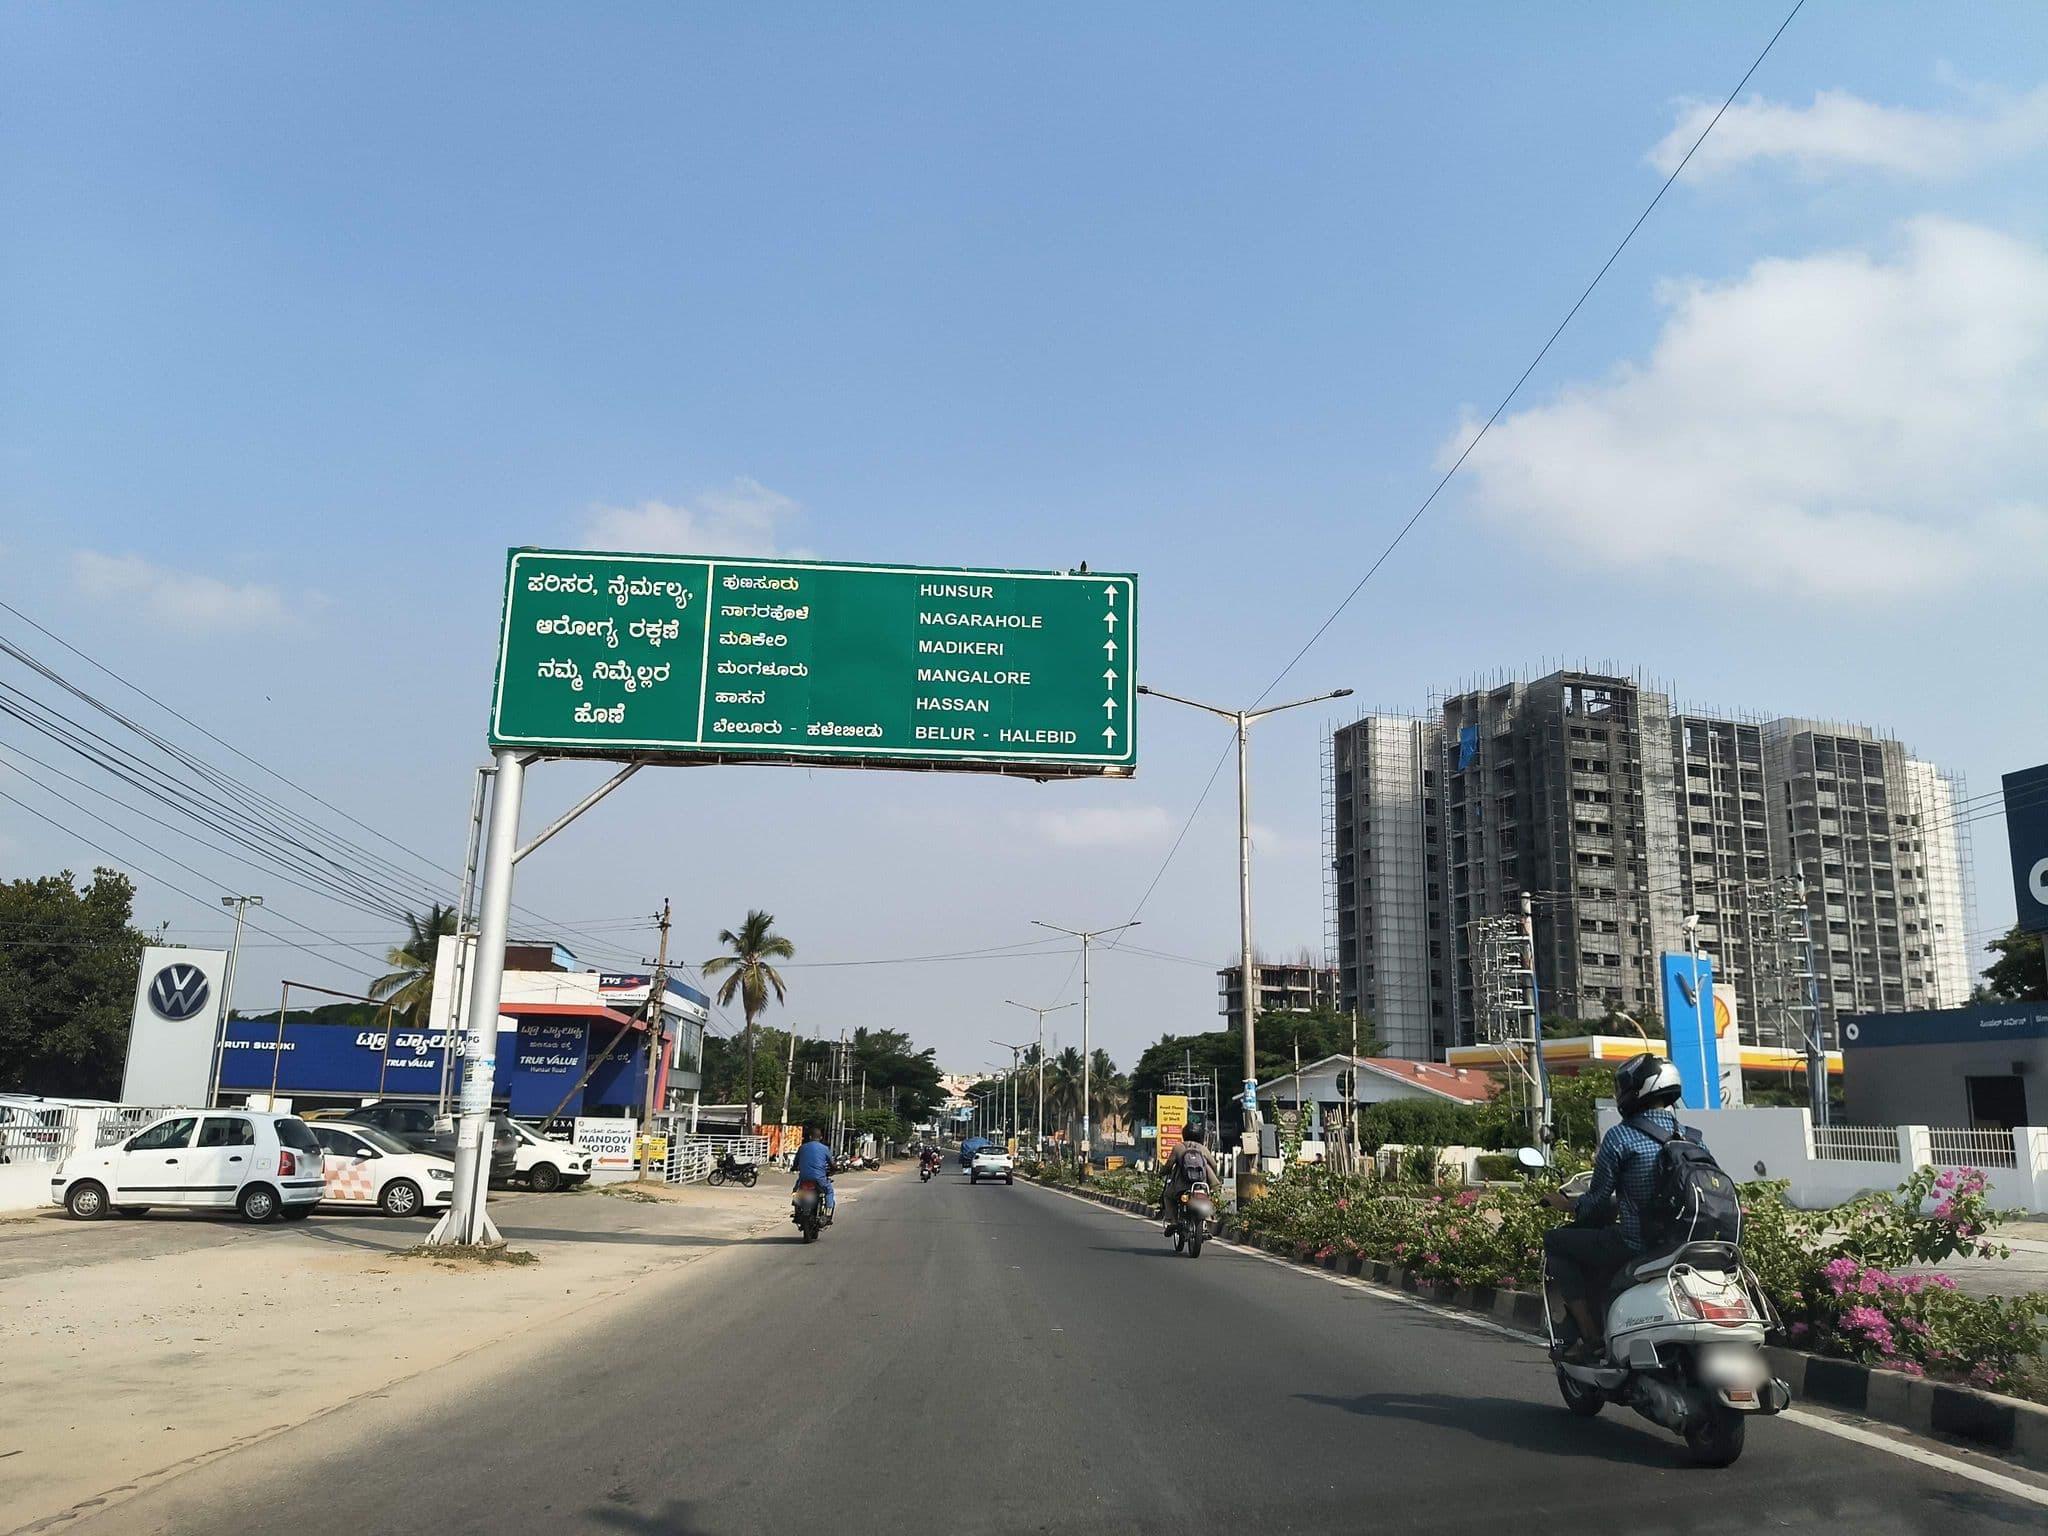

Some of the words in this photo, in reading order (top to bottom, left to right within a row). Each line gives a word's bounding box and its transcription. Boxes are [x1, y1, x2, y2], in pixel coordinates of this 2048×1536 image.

[722, 574, 800, 591] ಹುಣಸೂರು
[527, 572, 598, 596] ಪರಿಸರ,
[607, 574, 693, 610] ನೈರ್ಮಲ್ಯ,
[920, 584, 994, 599] HUNSUR
[720, 603, 810, 622] ನಾಗರಹೊಳೆ
[919, 612, 1043, 629] NAGARAHOLE
[535, 614, 619, 649] ಆರೋಗ್ಯ
[629, 618, 680, 648] ರಕ್ಷಣೆ
[719, 630, 788, 647] ಮಡಿಕೇರಿ
[918, 640, 1004, 656] MADIKERI
[537, 657, 584, 692] ನಮ್ಮ
[592, 659, 671, 693] ನಿಮ್ಮೆಲ್ಲರ
[717, 659, 809, 677] ಮಂಗಳೂರು
[917, 668, 1031, 685] MANGALORE
[715, 689, 766, 705] ಹಾಸನ
[916, 697, 989, 713] HASSAN
[574, 702, 626, 724] ಹೊಣೆ
[712, 718, 783, 734] ಬೇಲೂರು
[915, 726, 976, 741] BELUR
[999, 728, 1077, 744] HALEBID
[601, 976, 622, 985] TVS
[253, 1041, 295, 1051] SUZUKI
[467, 1035, 480, 1044] PG
[386, 1058, 408, 1068] TRUE
[408, 1057, 435, 1068] VALUE
[519, 1055, 545, 1065] TRUE
[546, 1054, 579, 1066] VALUE
[552, 1119, 573, 1128] EXA
[578, 1134, 632, 1145] MANDOVI
